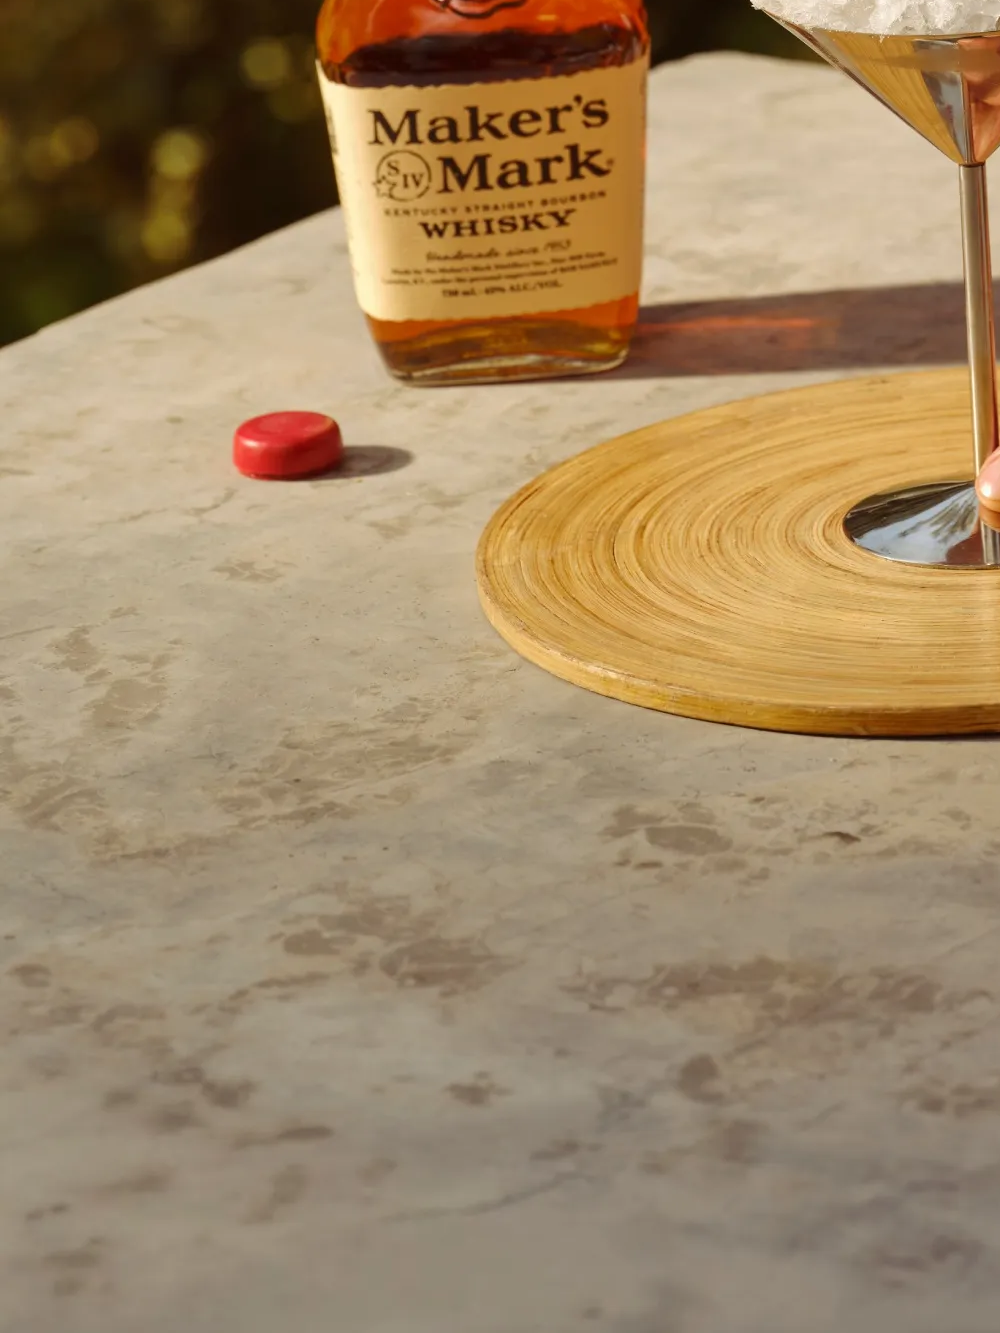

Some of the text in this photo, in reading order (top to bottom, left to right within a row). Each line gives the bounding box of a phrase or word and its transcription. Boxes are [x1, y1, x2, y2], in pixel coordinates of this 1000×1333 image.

[367, 94, 610, 146] Maker's
[436, 143, 612, 194] Mark
[383, 190, 607, 217] KENTUCKY STRAIGHT BOURBON
[418, 208, 577, 239] WHISKY
